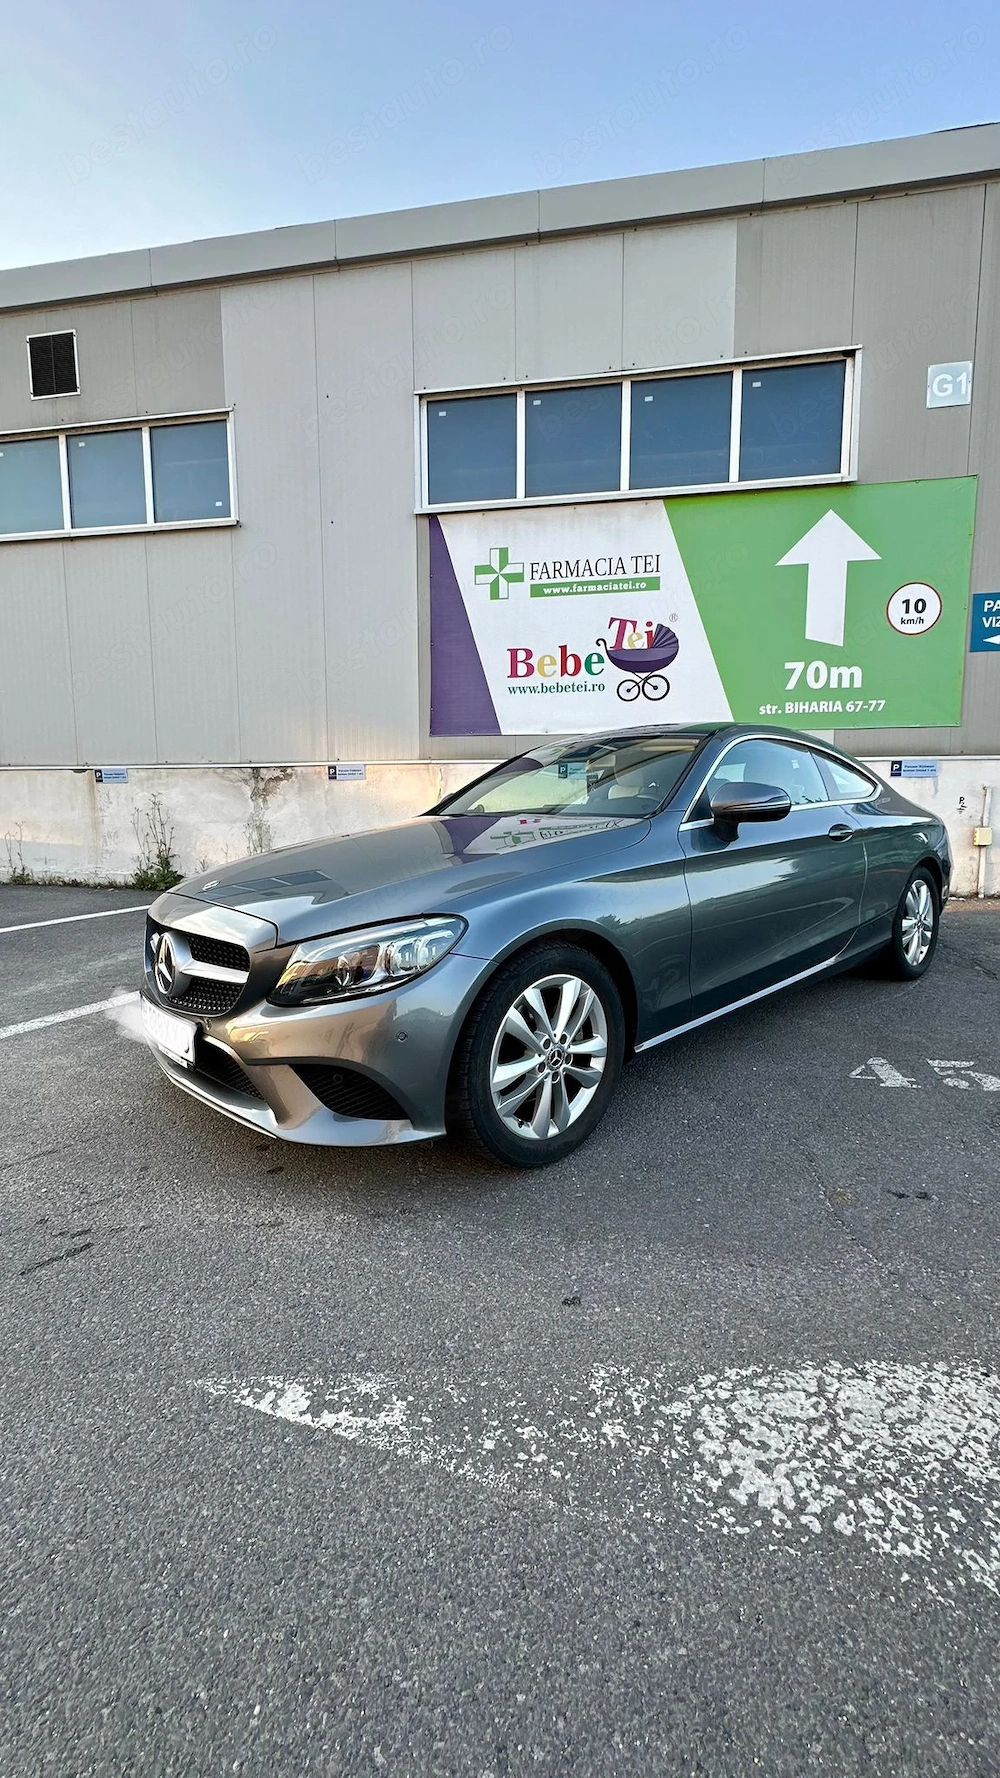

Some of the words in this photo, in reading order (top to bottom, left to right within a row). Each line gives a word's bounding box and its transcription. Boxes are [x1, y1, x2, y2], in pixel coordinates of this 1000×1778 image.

[932, 371, 968, 398] G1
[530, 557, 626, 581] FARMACIA
[631, 554, 661, 574] TEI
[543, 582, 647, 595] www.farmaciatei.ro
[902, 598, 927, 615] 10
[900, 617, 925, 625] km/h
[608, 617, 654, 650] Tei
[507, 644, 605, 679] Bebe
[784, 661, 863, 691] 70m
[508, 681, 606, 695] www.bebetei.ro
[759, 703, 782, 715] str.
[785, 701, 843, 714] BIHARIA
[846, 699, 886, 713] 67-77
